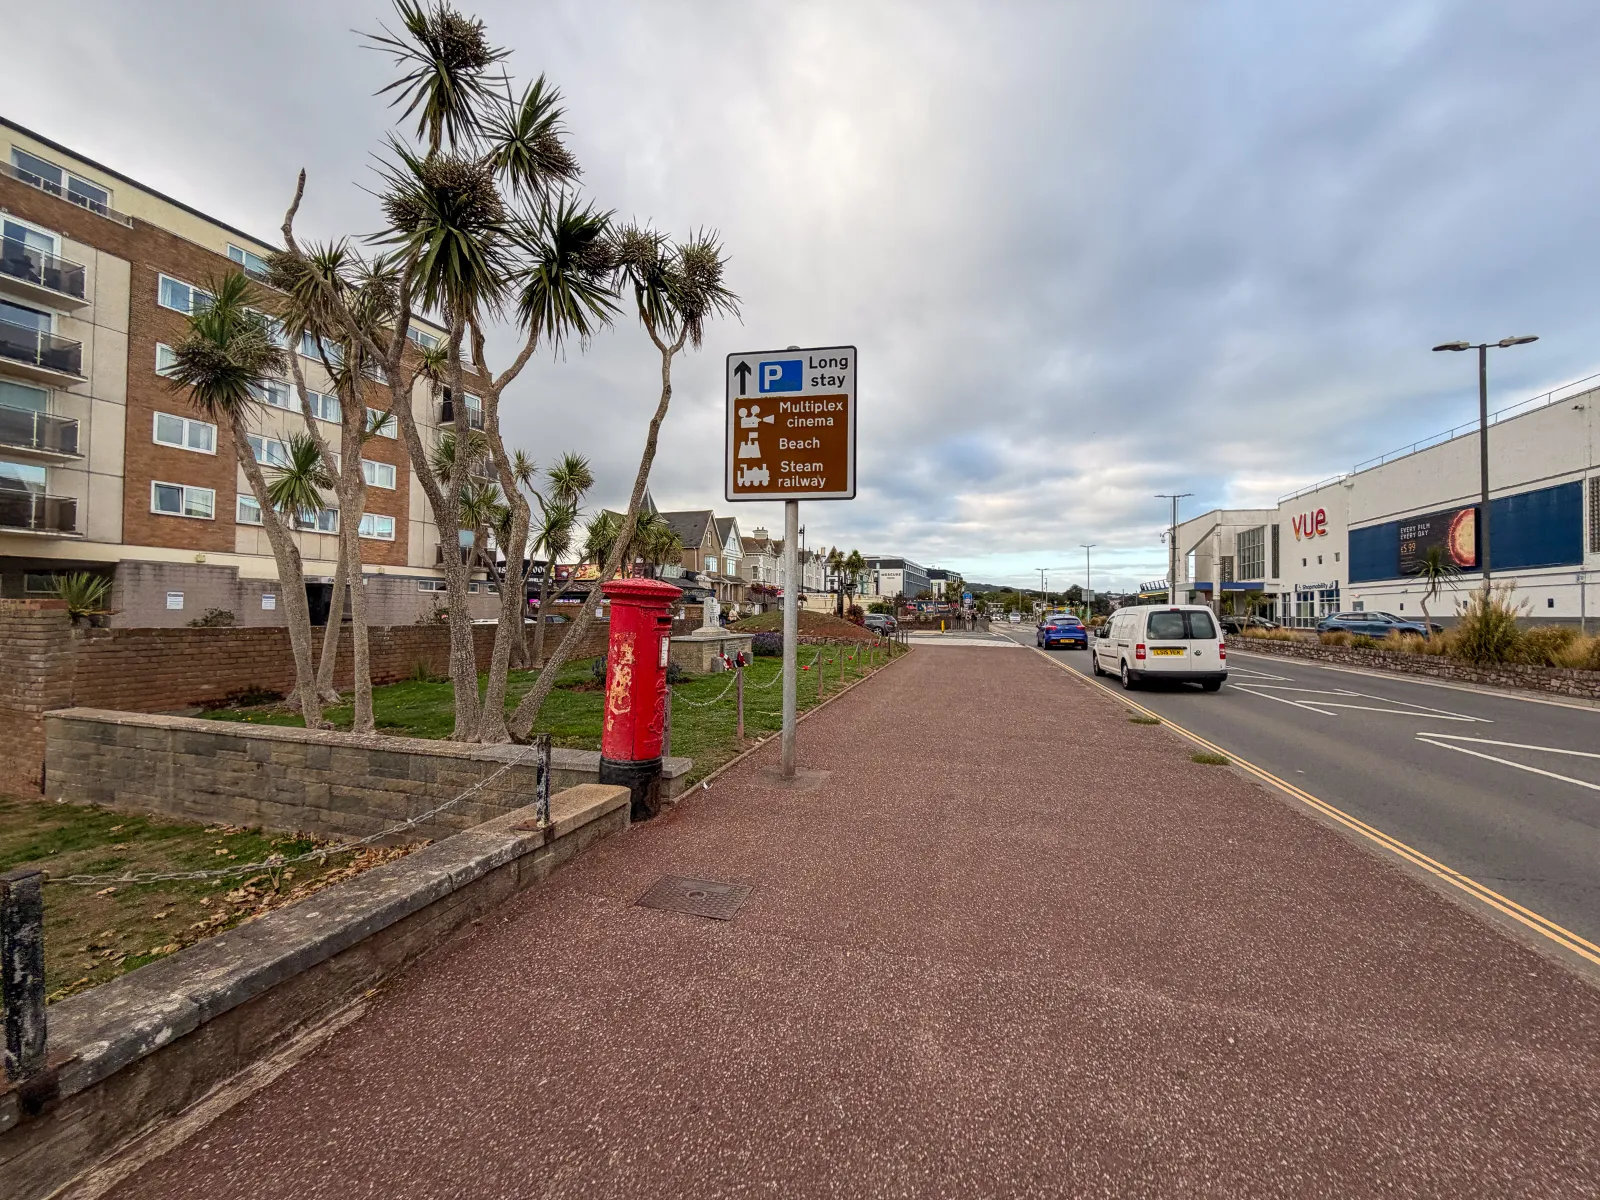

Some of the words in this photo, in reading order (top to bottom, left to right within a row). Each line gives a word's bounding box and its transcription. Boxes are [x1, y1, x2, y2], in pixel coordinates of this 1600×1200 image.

[809, 356, 849, 370] Long
[764, 365, 783, 390] P
[810, 374, 846, 388] stay
[779, 400, 844, 414] Multiplex
[786, 416, 834, 428] cinema
[779, 437, 820, 450] Beach
[780, 461, 824, 473] Steam
[778, 476, 826, 488] railway
[1400, 526, 1416, 534] EVERY
